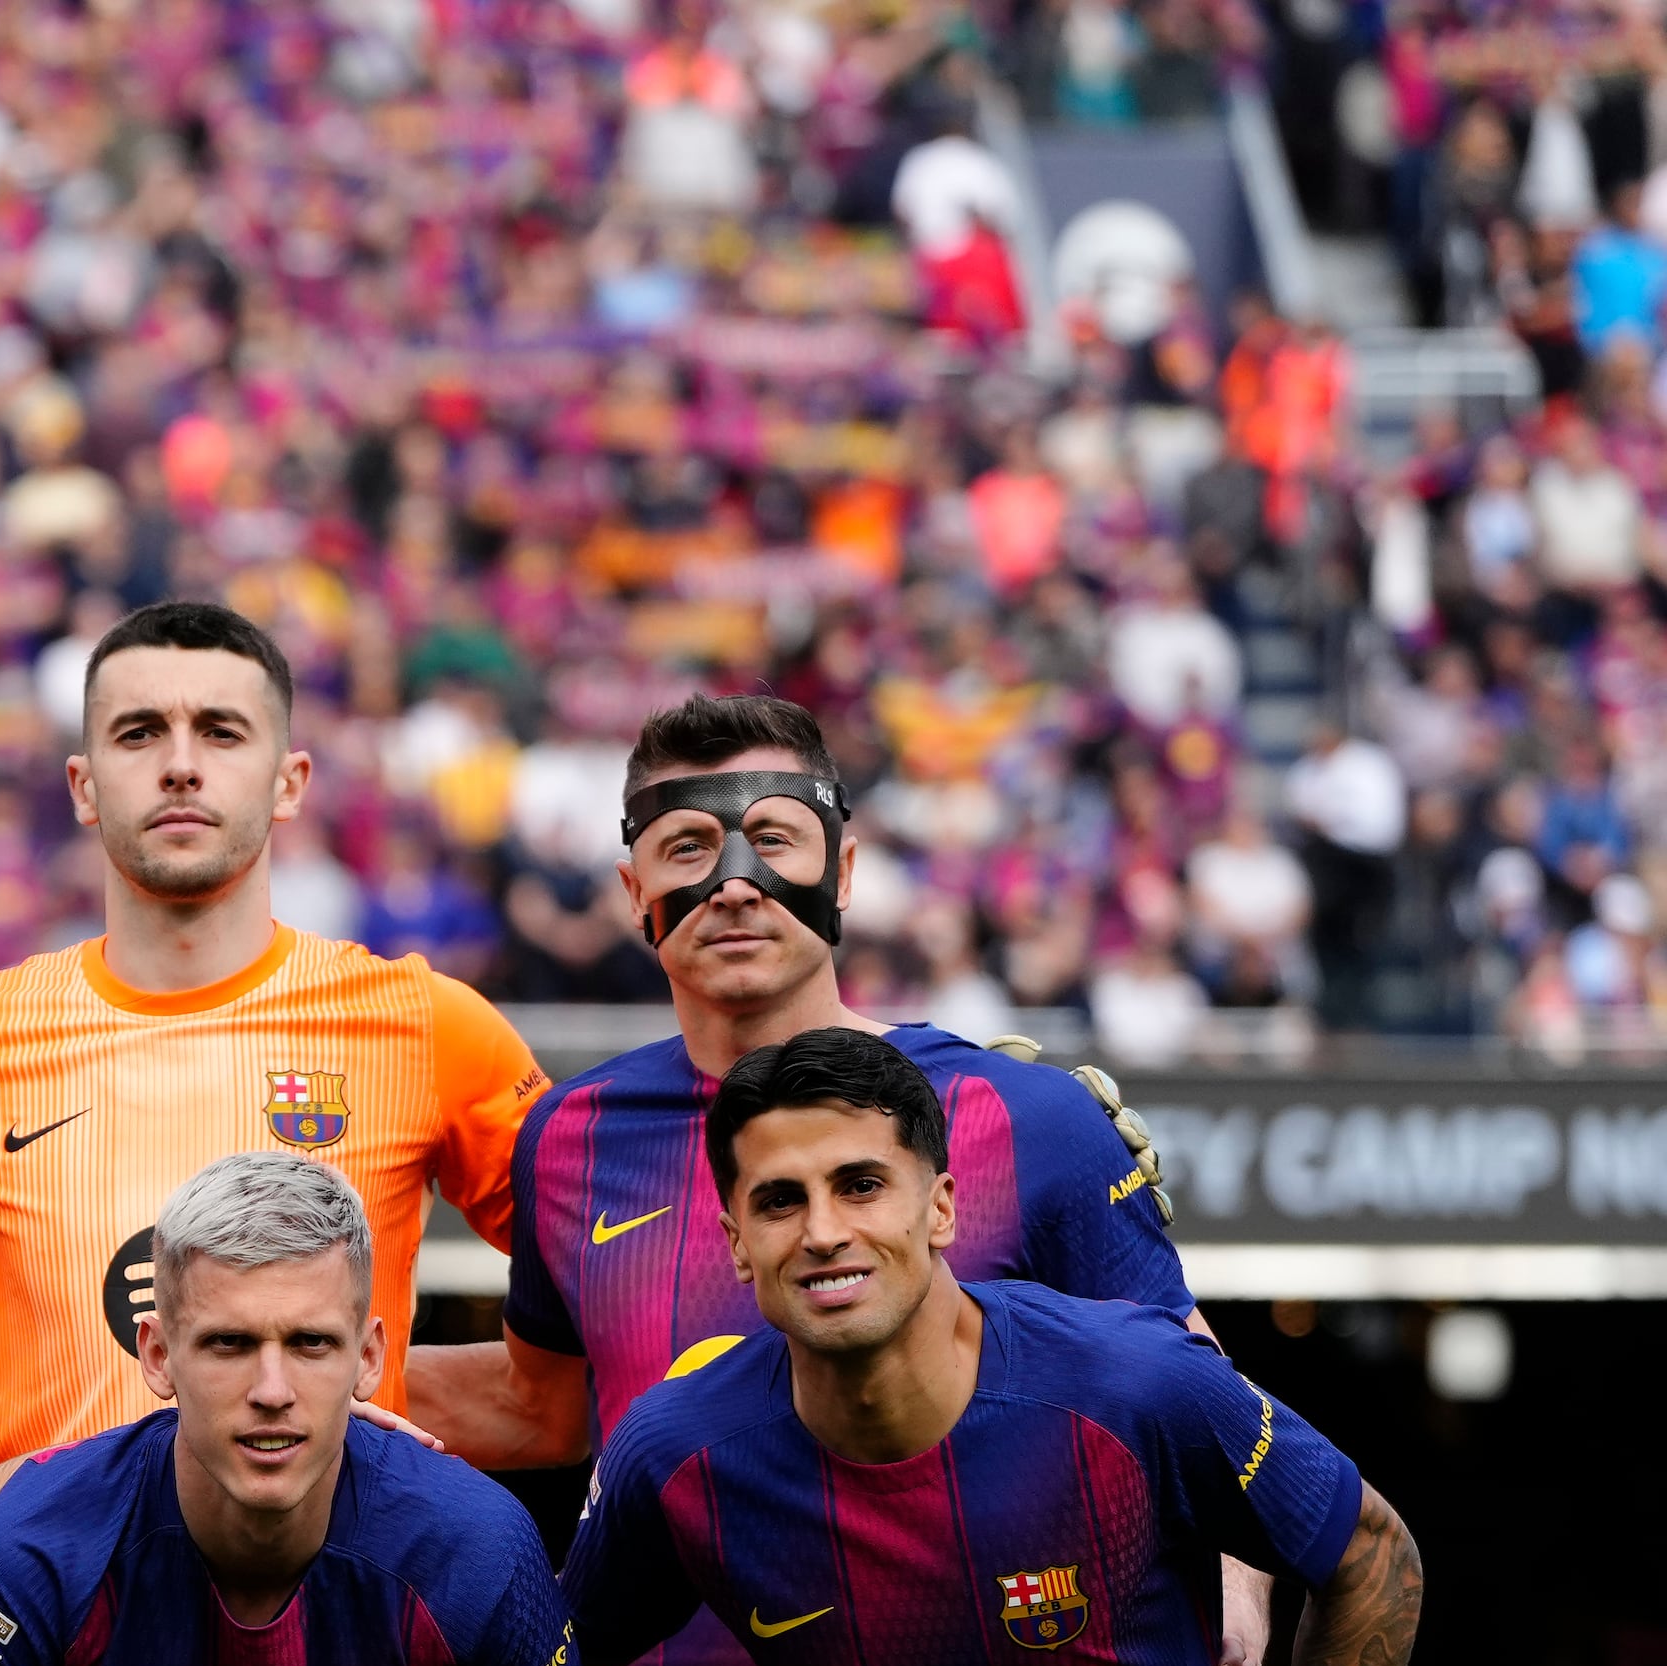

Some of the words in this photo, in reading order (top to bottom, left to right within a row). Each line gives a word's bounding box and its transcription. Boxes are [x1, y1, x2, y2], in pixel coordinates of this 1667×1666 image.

[291, 1102, 324, 1113] FCB
[1264, 1101, 1561, 1221] CAMP
[1027, 1601, 1061, 1616] FCB
